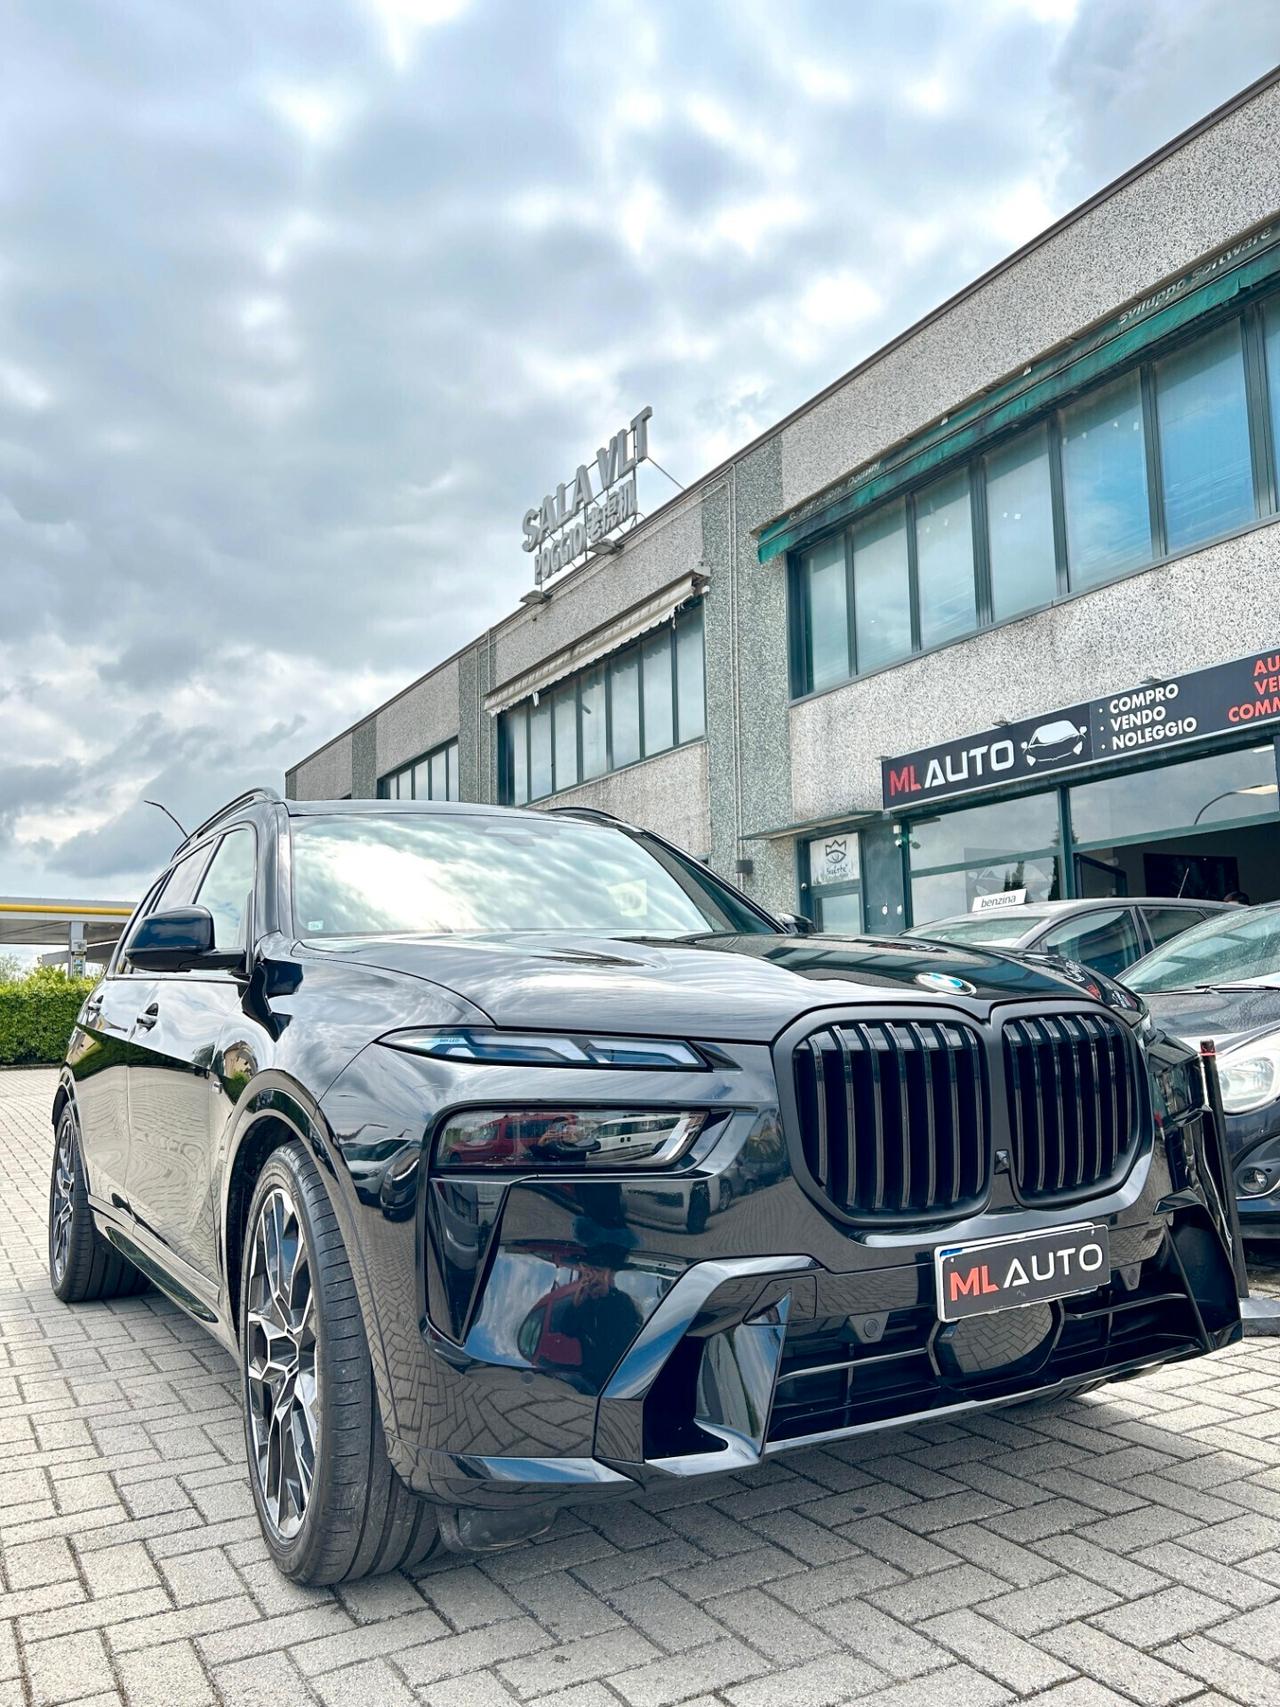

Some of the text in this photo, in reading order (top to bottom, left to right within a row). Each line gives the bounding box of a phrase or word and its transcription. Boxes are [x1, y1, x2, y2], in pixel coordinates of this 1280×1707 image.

[522, 406, 653, 552] SALA VLT
[535, 522, 587, 585] POGGIO
[1109, 683, 1179, 714] COMPRO
[1110, 706, 1166, 732] VENDO
[1112, 717, 1197, 750] NOLEGGIO
[923, 739, 1014, 789] AUTO
[981, 895, 1017, 908] benzina
[950, 1243, 1103, 1301] ML AUTO
